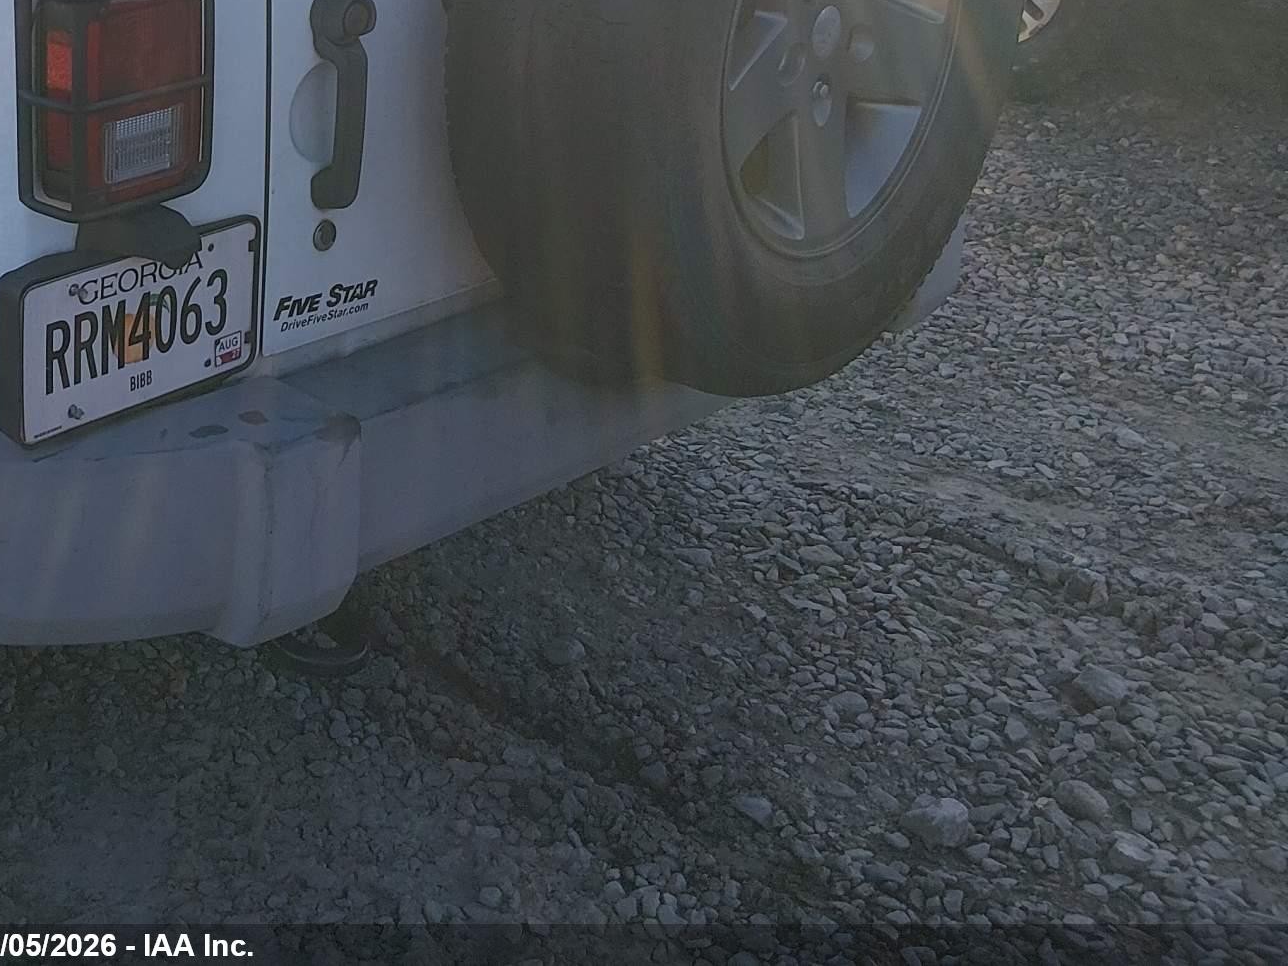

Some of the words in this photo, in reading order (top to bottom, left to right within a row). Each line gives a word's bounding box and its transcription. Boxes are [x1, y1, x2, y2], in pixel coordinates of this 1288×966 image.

[272, 292, 323, 321] FIVE
[326, 279, 378, 308] STAR
[45, 268, 228, 395] RRM4063
[280, 303, 369, 332] DriveFiveStar.com
[219, 337, 238, 352] AUG
[129, 370, 153, 391] BIBB
